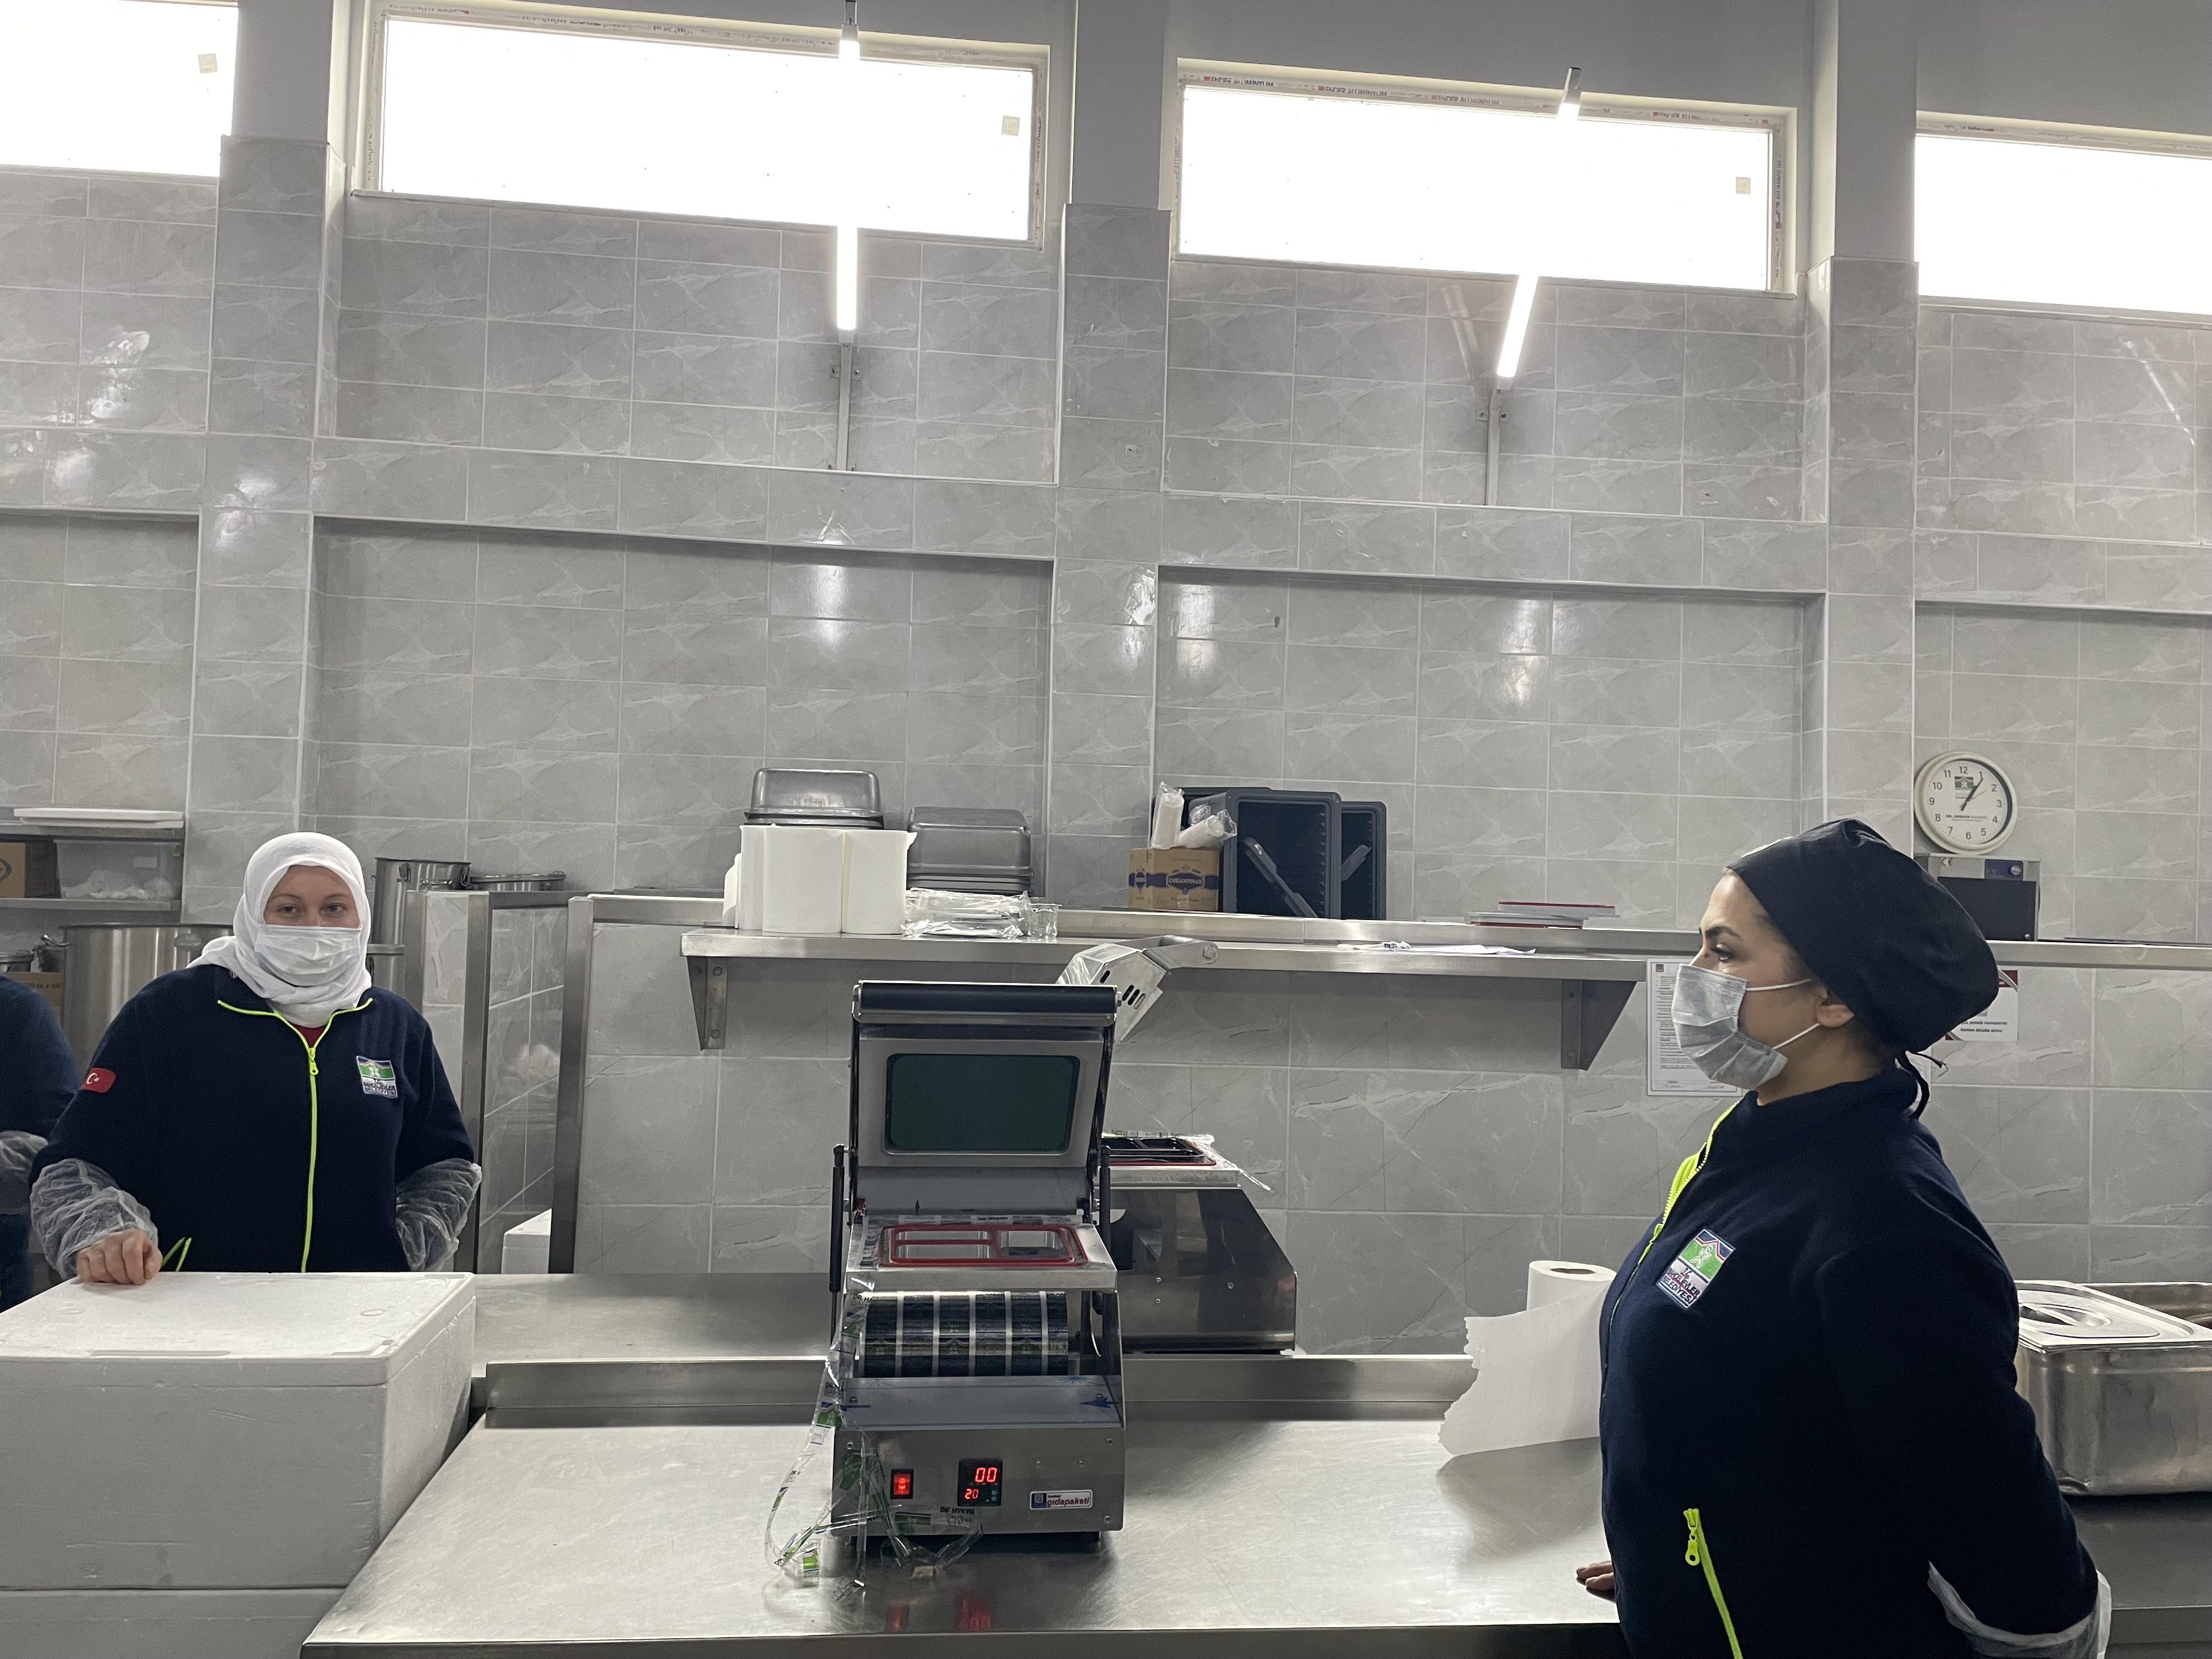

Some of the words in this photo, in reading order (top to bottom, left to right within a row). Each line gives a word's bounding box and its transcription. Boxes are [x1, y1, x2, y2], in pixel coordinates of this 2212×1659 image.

[1933, 782, 1942, 790] 10
[1929, 797, 1935, 805] 9
[1935, 814, 1940, 822] 8
[1948, 826, 1953, 834] 7
[1981, 828, 1986, 836] 5
[1966, 831, 1971, 839] 6
[975, 1467, 997, 1482] 00
[965, 1488, 979, 1499] 20
